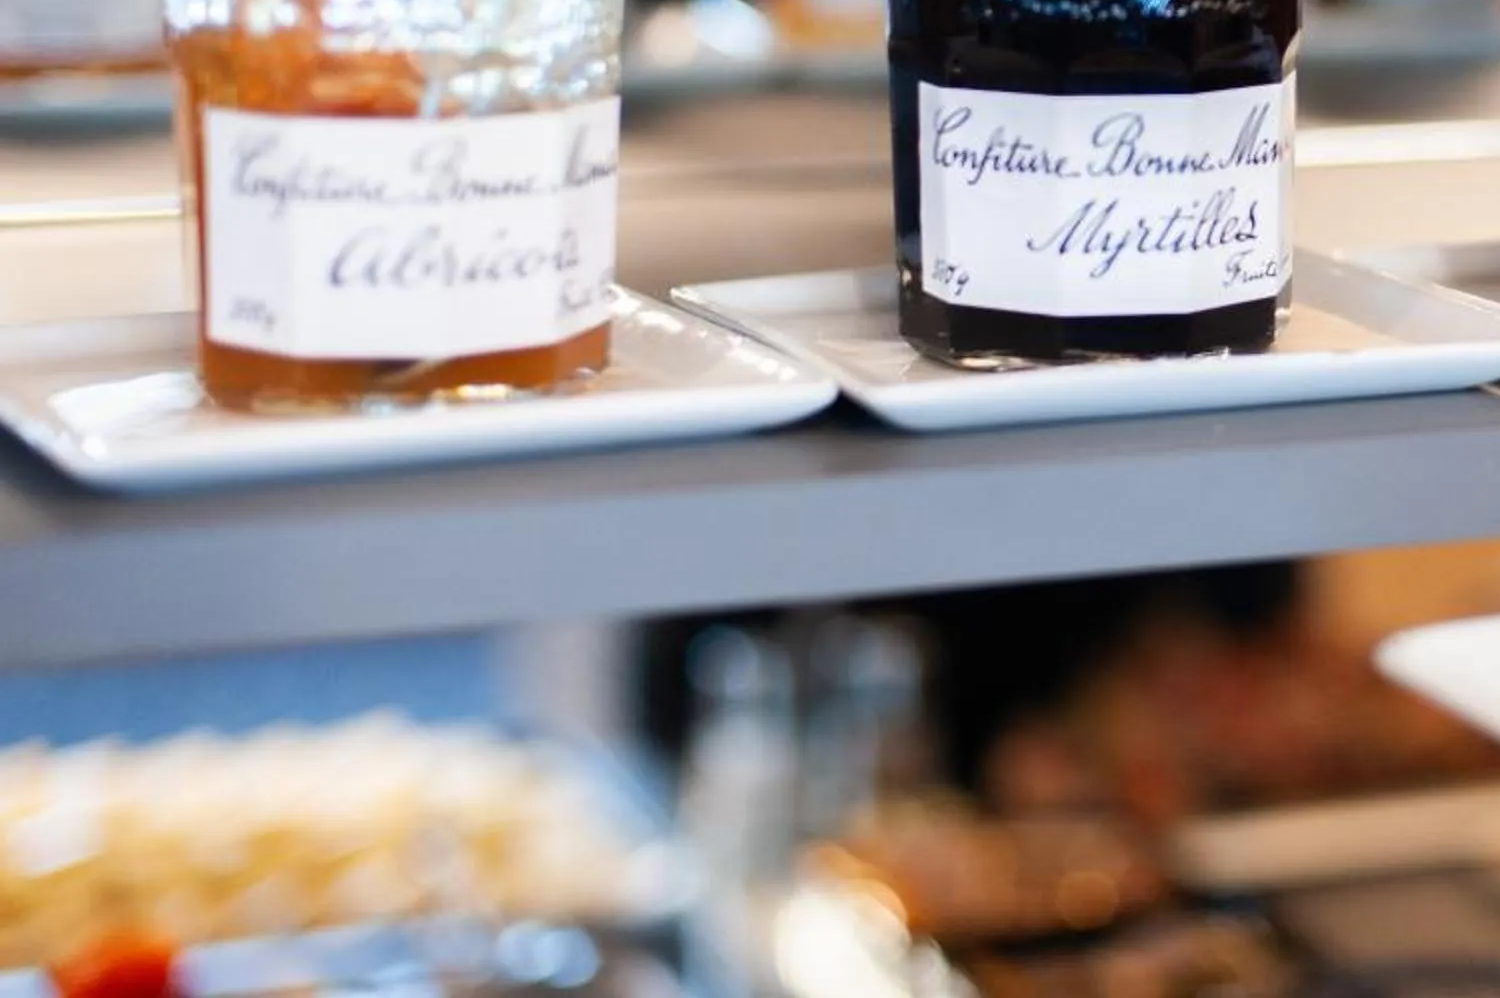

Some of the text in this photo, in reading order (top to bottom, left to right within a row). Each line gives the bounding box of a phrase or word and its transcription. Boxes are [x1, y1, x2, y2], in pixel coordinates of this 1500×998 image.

[932, 106, 1074, 186] Confiture
[1086, 111, 1213, 178] Bonne
[1026, 185, 1259, 279] Myrtilles
